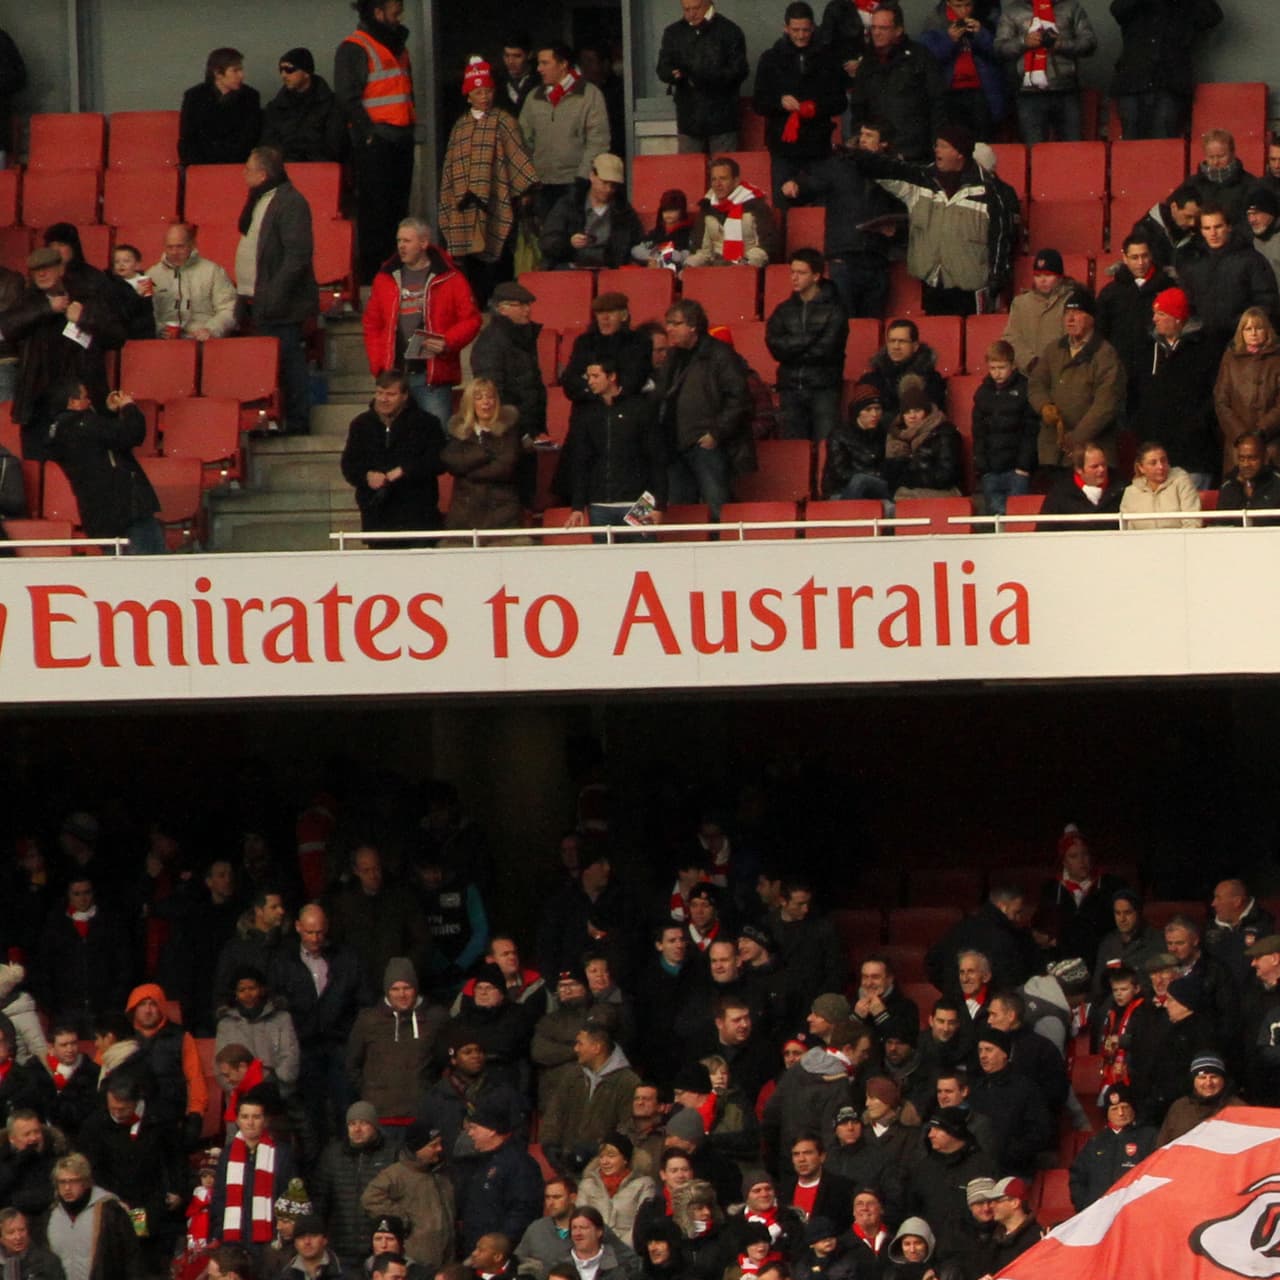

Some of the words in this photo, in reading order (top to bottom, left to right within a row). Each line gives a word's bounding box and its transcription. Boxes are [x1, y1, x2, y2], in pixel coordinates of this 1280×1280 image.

[26, 576, 449, 669] Emirates
[487, 587, 579, 660] to
[613, 560, 1030, 656] Australia
